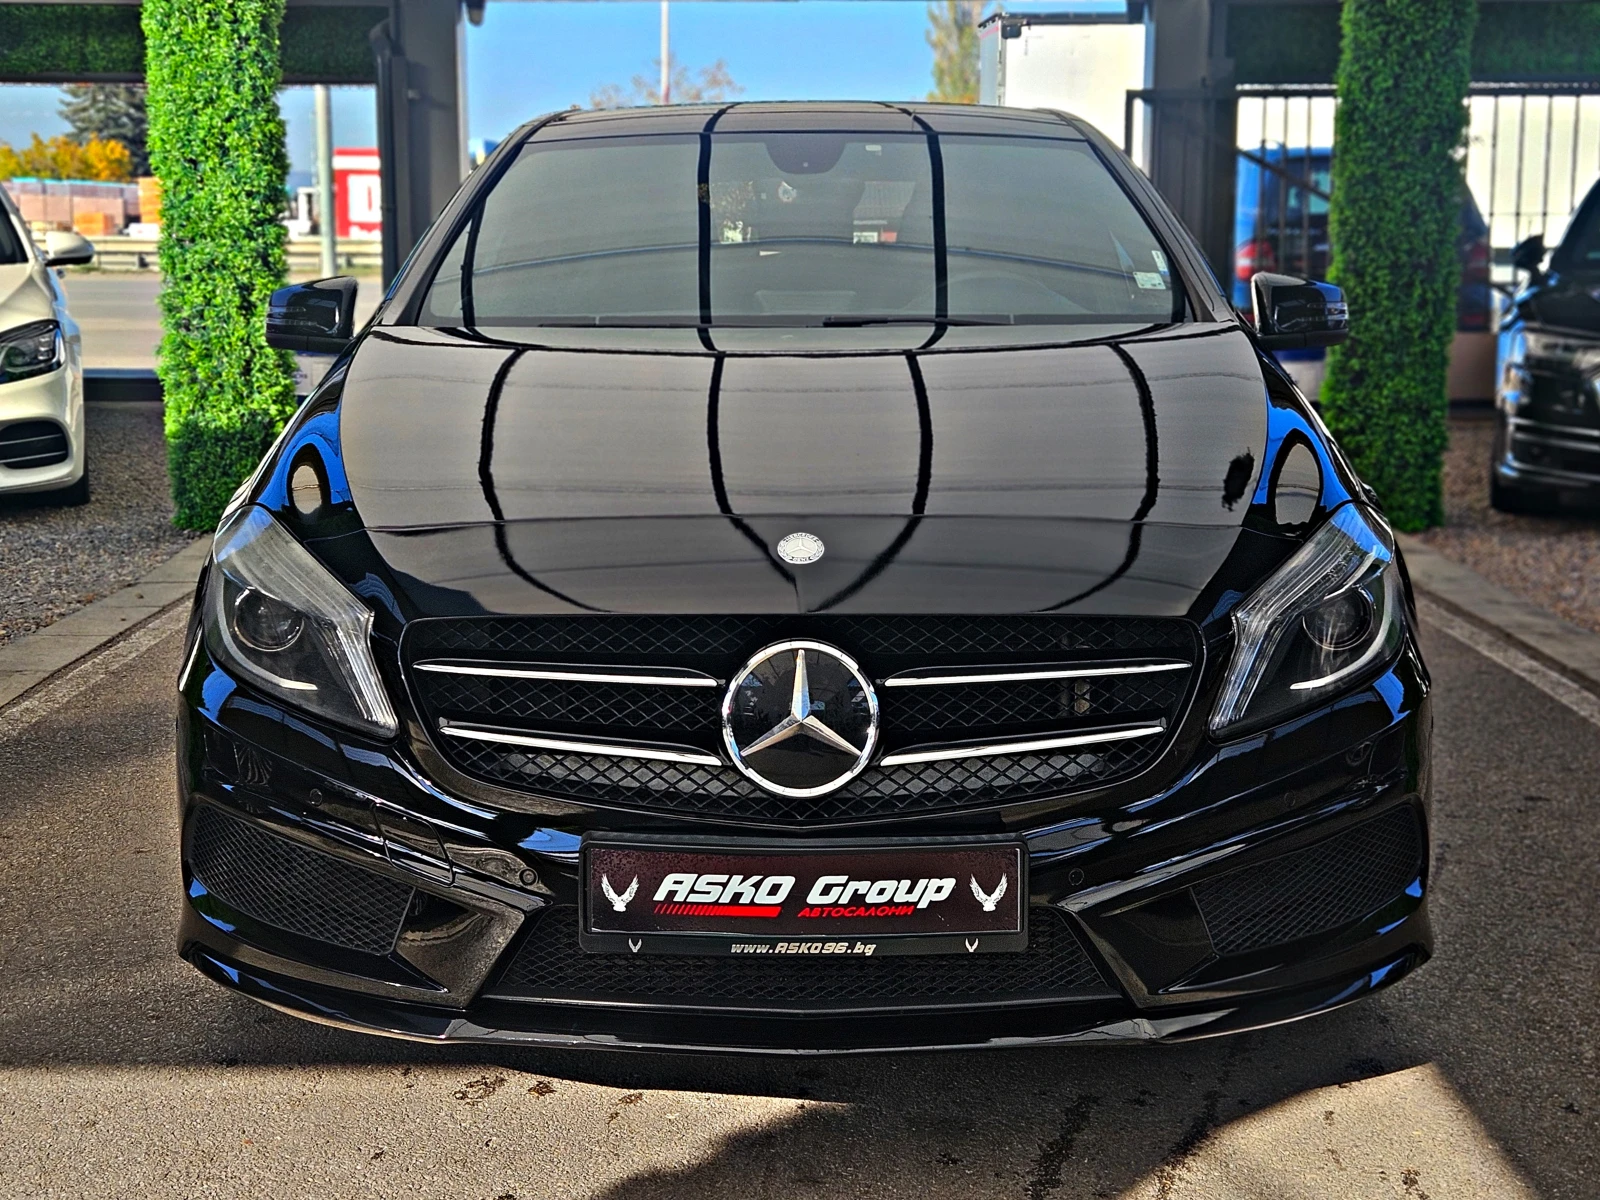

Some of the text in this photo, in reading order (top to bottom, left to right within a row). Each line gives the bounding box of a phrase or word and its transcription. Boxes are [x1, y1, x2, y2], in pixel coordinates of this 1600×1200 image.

[652, 873, 957, 909] ASKO Group
[797, 905, 916, 918] АВТОСАЛОНИ
[730, 941, 877, 956] www.ASKO96.bg
